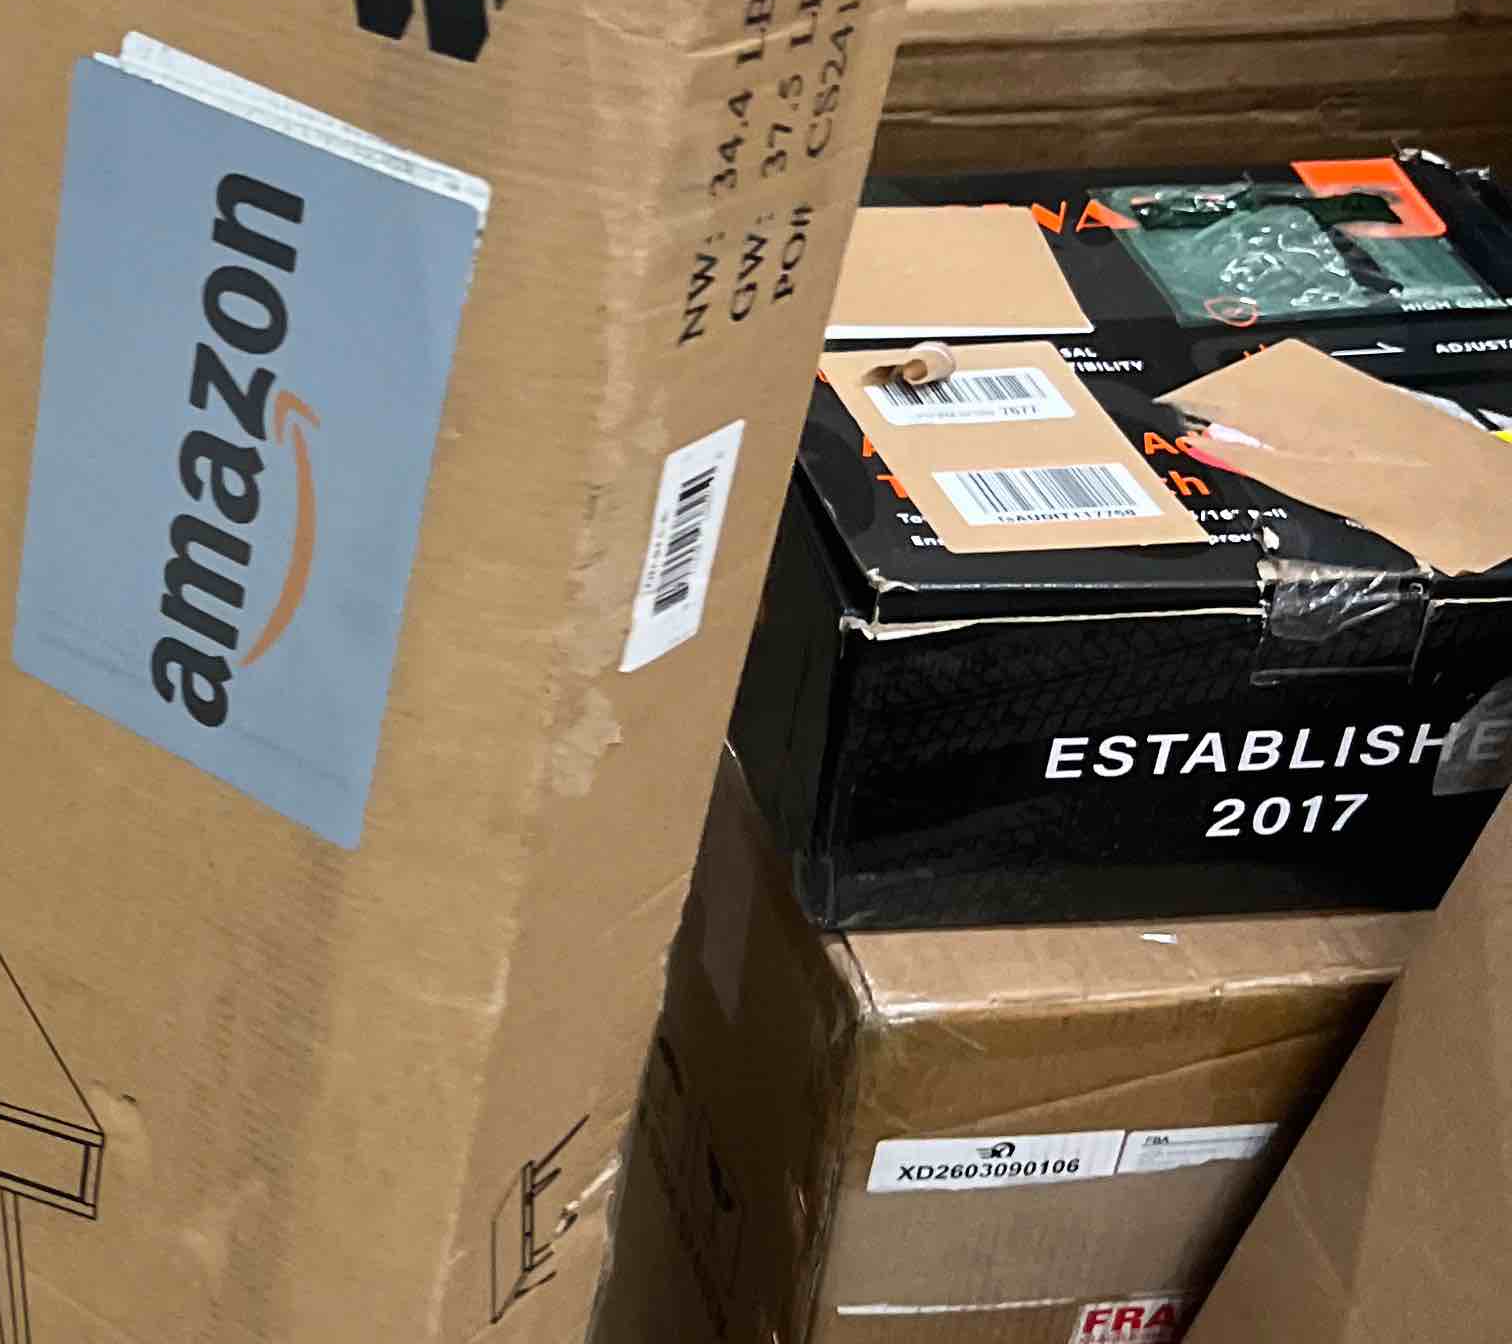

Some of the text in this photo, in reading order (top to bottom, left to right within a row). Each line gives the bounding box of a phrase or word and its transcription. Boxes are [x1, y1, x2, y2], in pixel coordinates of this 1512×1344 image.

[150, 171, 305, 728] amazon
[1205, 792, 1369, 838] 2017
[897, 1157, 1080, 1183] XD2603090106
